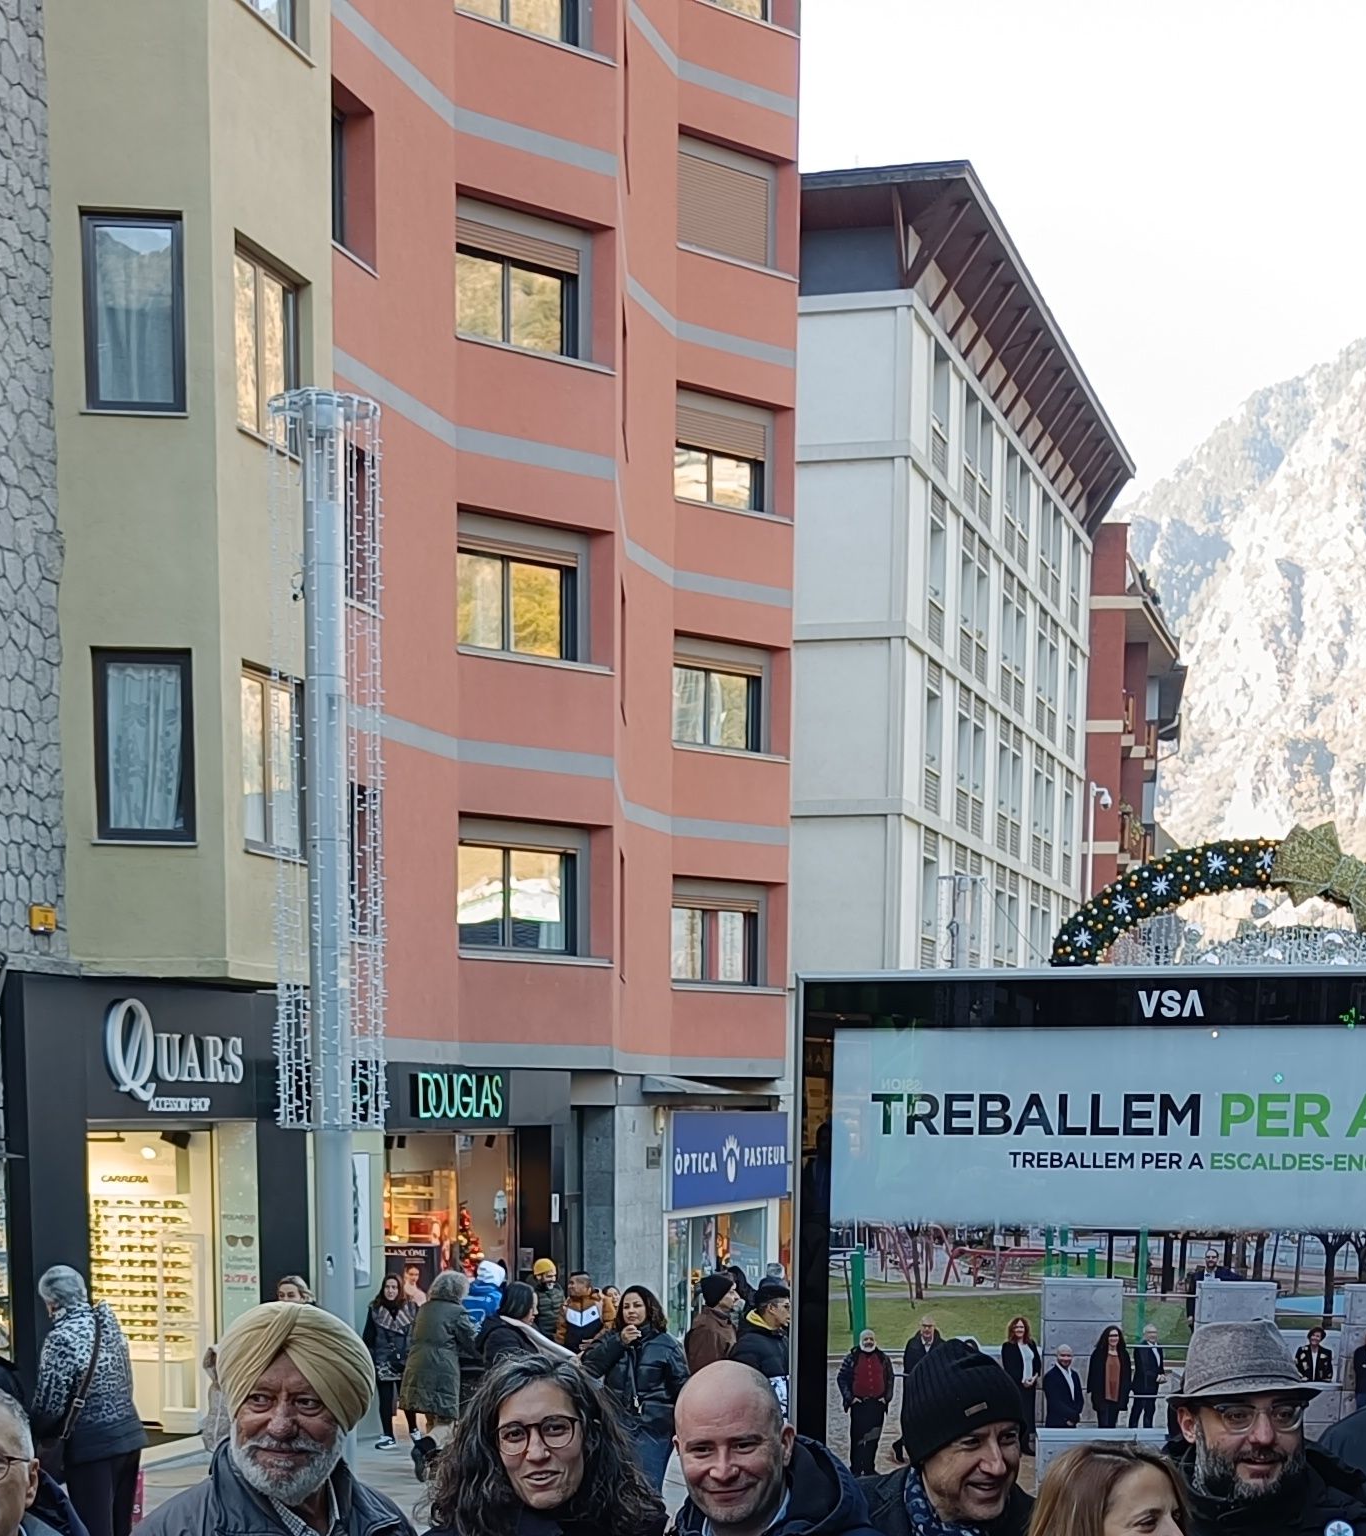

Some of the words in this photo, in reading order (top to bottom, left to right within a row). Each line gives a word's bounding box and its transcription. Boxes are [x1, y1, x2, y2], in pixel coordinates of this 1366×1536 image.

[1138, 989, 1205, 1019] VSA
[106, 998, 244, 1101] QUARS
[148, 1097, 190, 1112] ACCESSORY
[191, 1097, 211, 1112] SHOP
[417, 1071, 503, 1119] DOUGLAS
[871, 1092, 1201, 1137] TREBALLEM
[1220, 1092, 1331, 1138] PER
[674, 1147, 718, 1176] ÒPTICA
[744, 1145, 786, 1168] PASTEUR
[1009, 1151, 1135, 1170] TREBALLEM
[1141, 1152, 1183, 1171] PER
[1187, 1152, 1205, 1171] A
[101, 1174, 149, 1184] CARRERA
